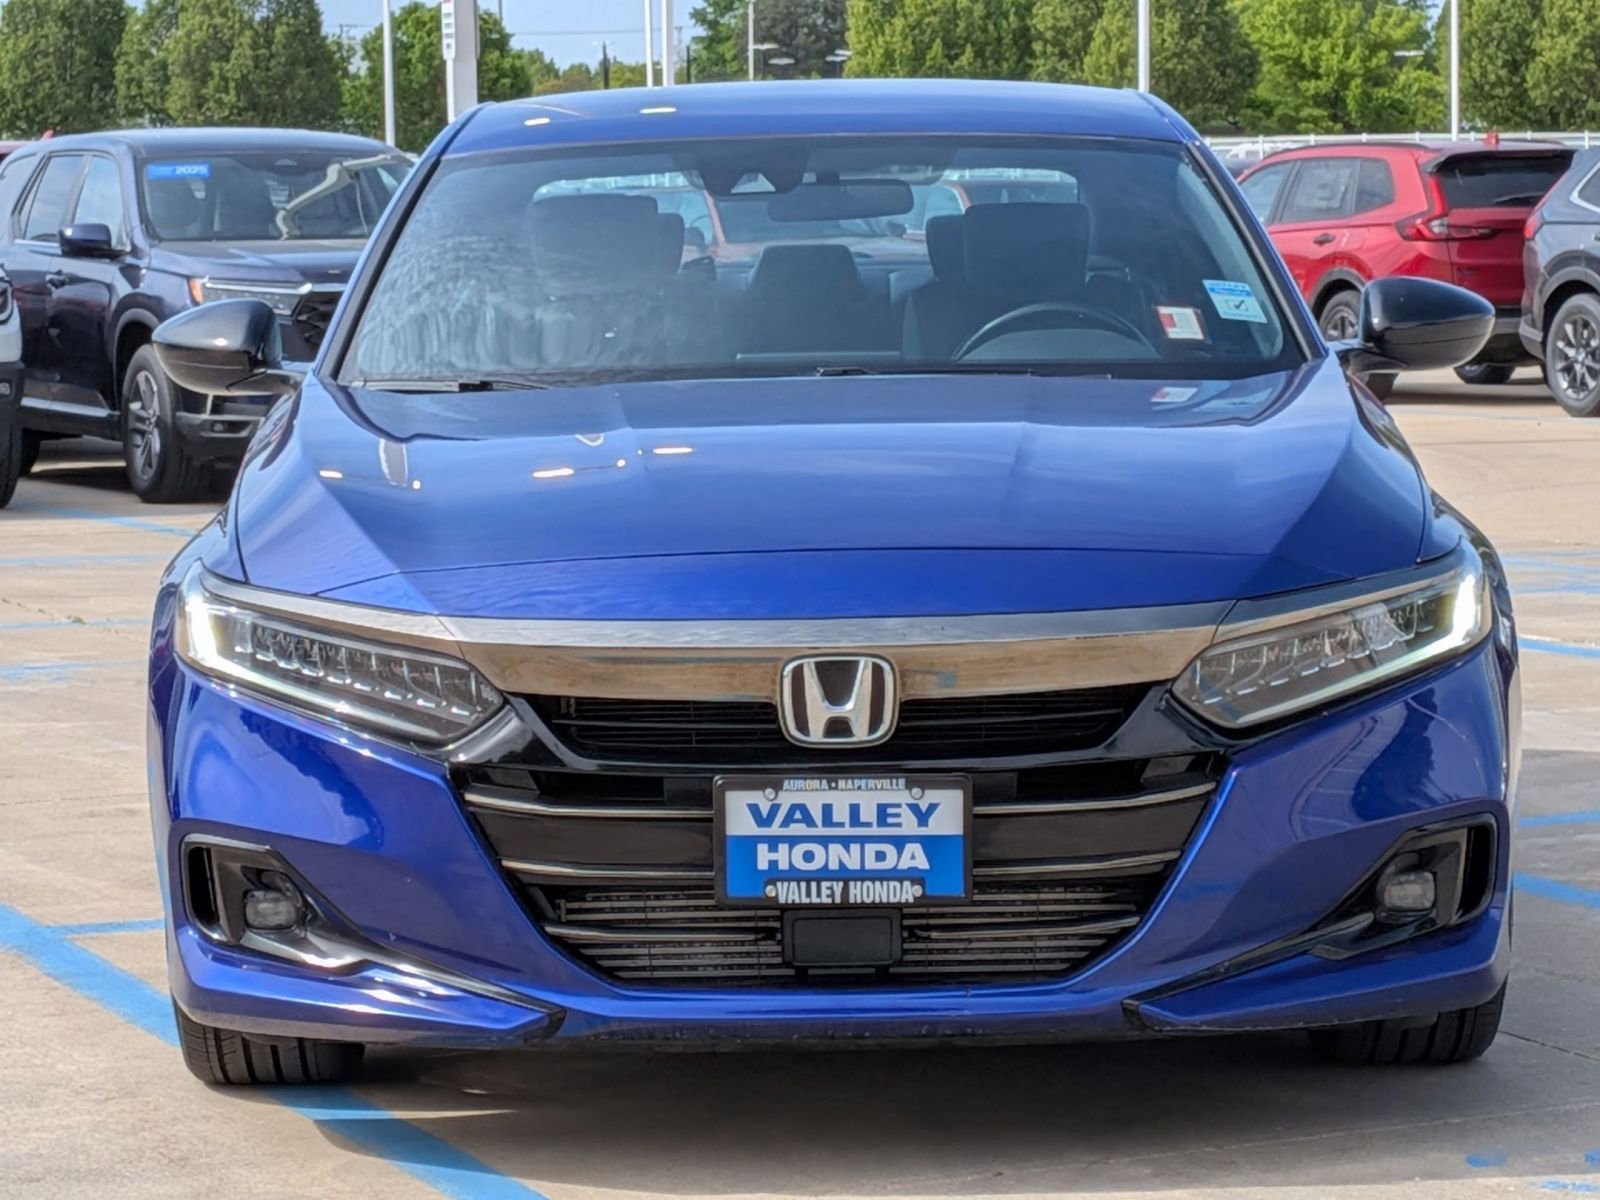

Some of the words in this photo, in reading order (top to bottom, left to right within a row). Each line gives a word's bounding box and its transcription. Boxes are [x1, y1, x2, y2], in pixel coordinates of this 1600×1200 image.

[783, 779, 828, 791] AURORA
[838, 778, 906, 790] NAPERVILLE
[746, 803, 941, 828] VALLEY
[757, 843, 930, 870] HONDA
[776, 881, 844, 904] VALLEY
[849, 881, 915, 904] HONDA
